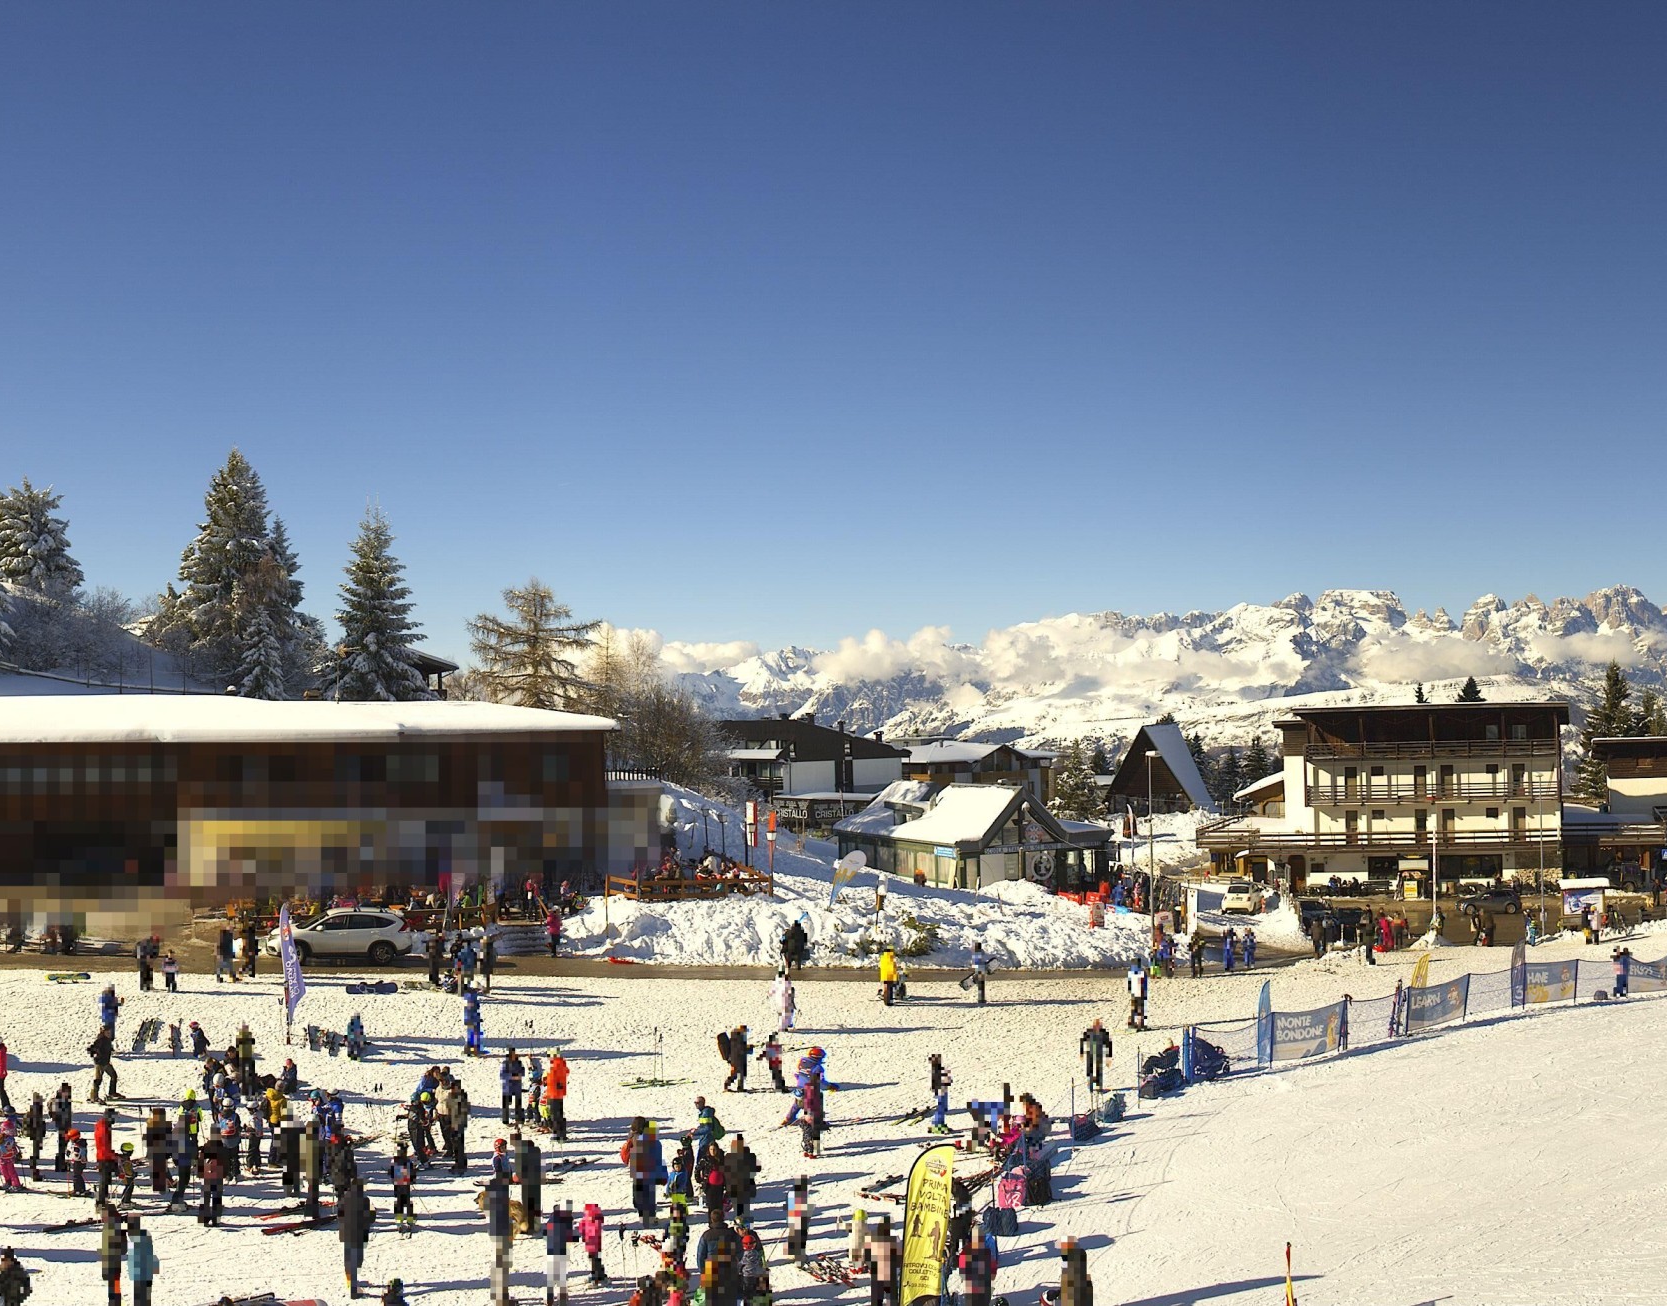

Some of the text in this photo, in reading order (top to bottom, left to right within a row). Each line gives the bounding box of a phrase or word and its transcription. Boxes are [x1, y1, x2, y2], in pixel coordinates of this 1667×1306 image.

[774, 809, 807, 819] CRISTALLO
[815, 809, 855, 819] CRISTALLO
[1527, 971, 1548, 984] HAVE
[1411, 991, 1441, 1009] LEARN
[1277, 1015, 1311, 1029] MONTE
[1276, 1025, 1324, 1040] BONDONE
[923, 1178, 948, 1194] PRIMA
[919, 1190, 947, 1206] VOLTA
